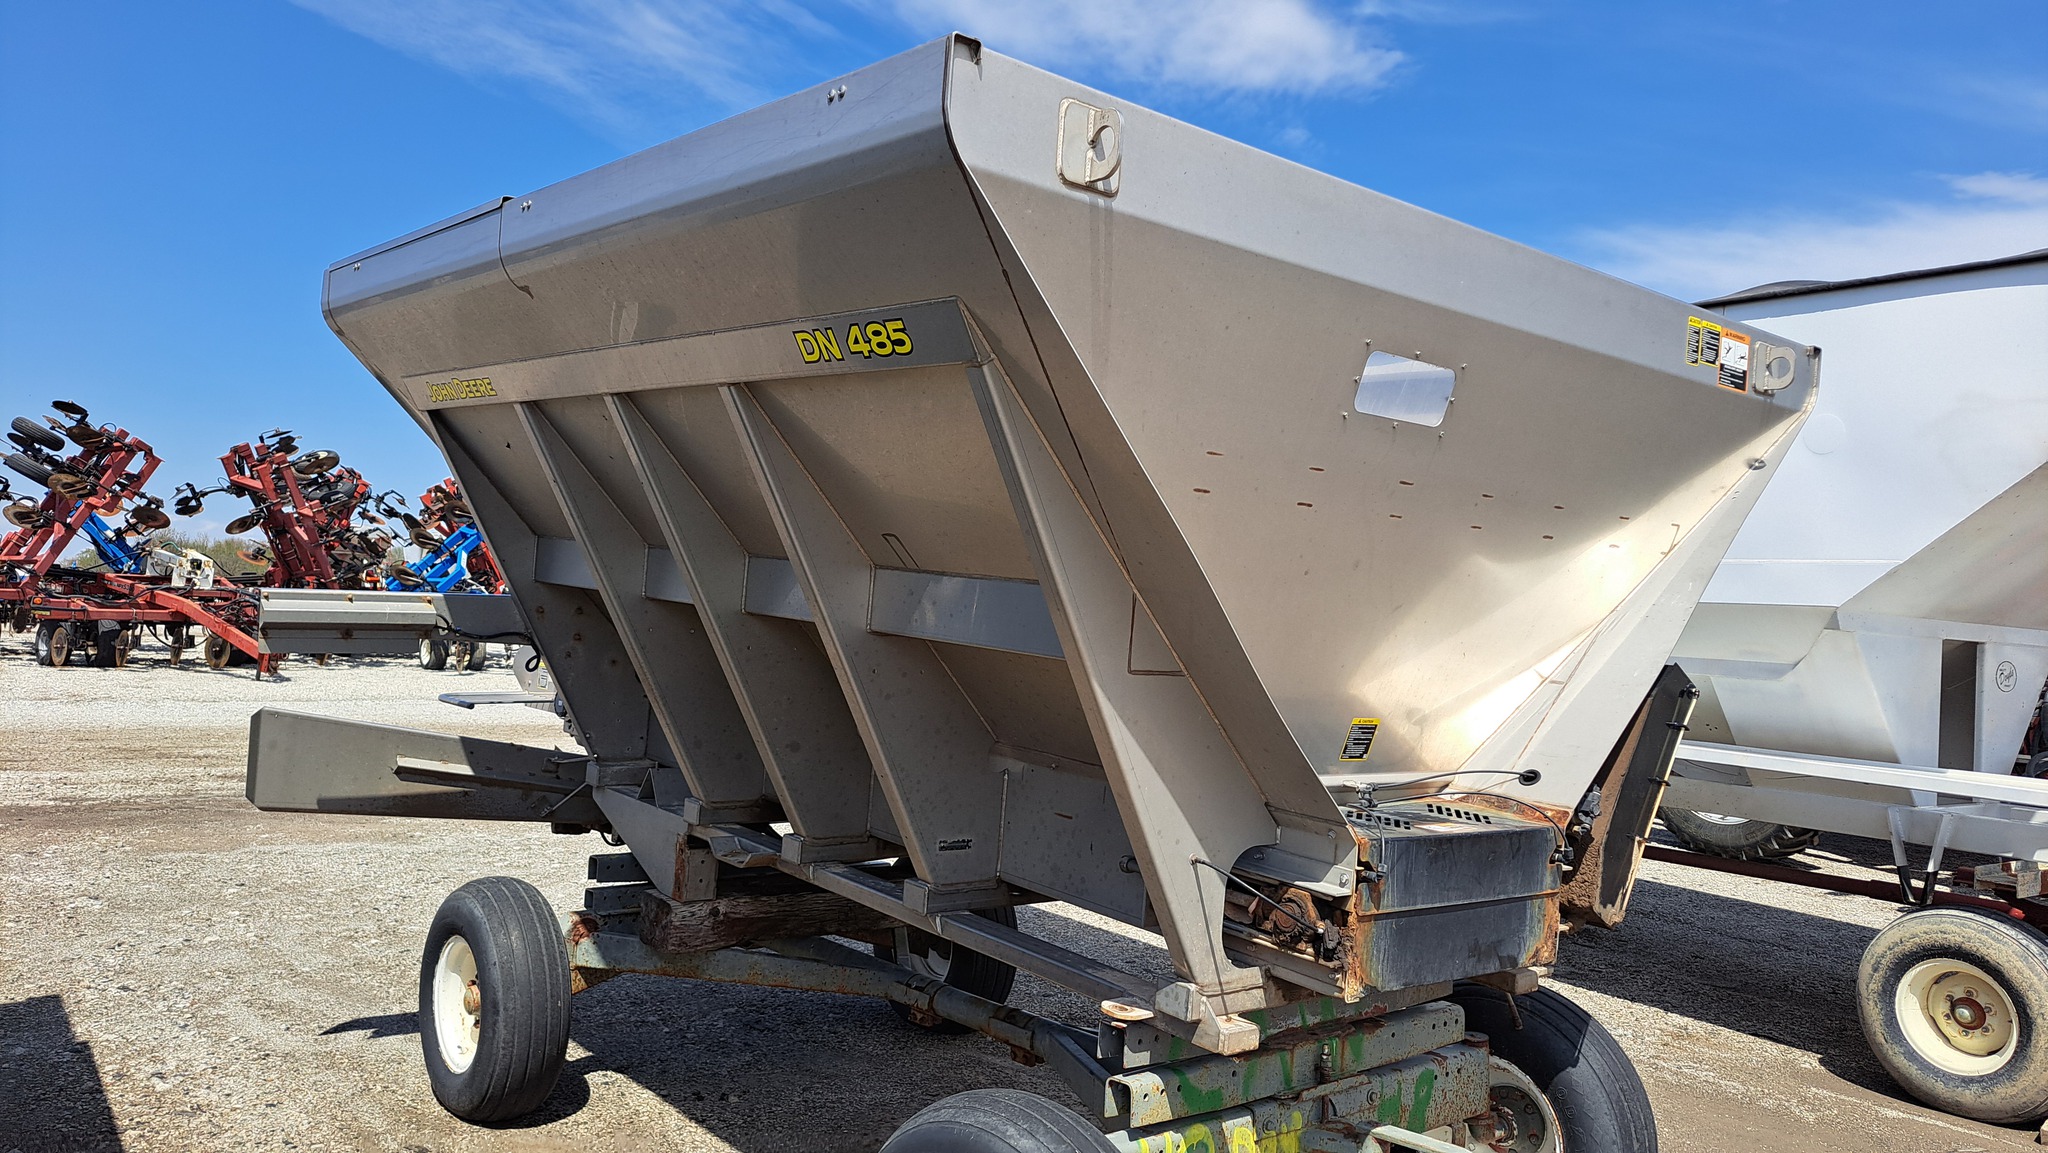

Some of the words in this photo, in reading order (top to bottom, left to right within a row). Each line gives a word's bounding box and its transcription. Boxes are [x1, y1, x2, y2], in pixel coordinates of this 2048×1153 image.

[792, 327, 845, 364] DN
[846, 318, 914, 359] 485
[426, 381, 460, 403] JOHN
[451, 377, 498, 400] DEERE
